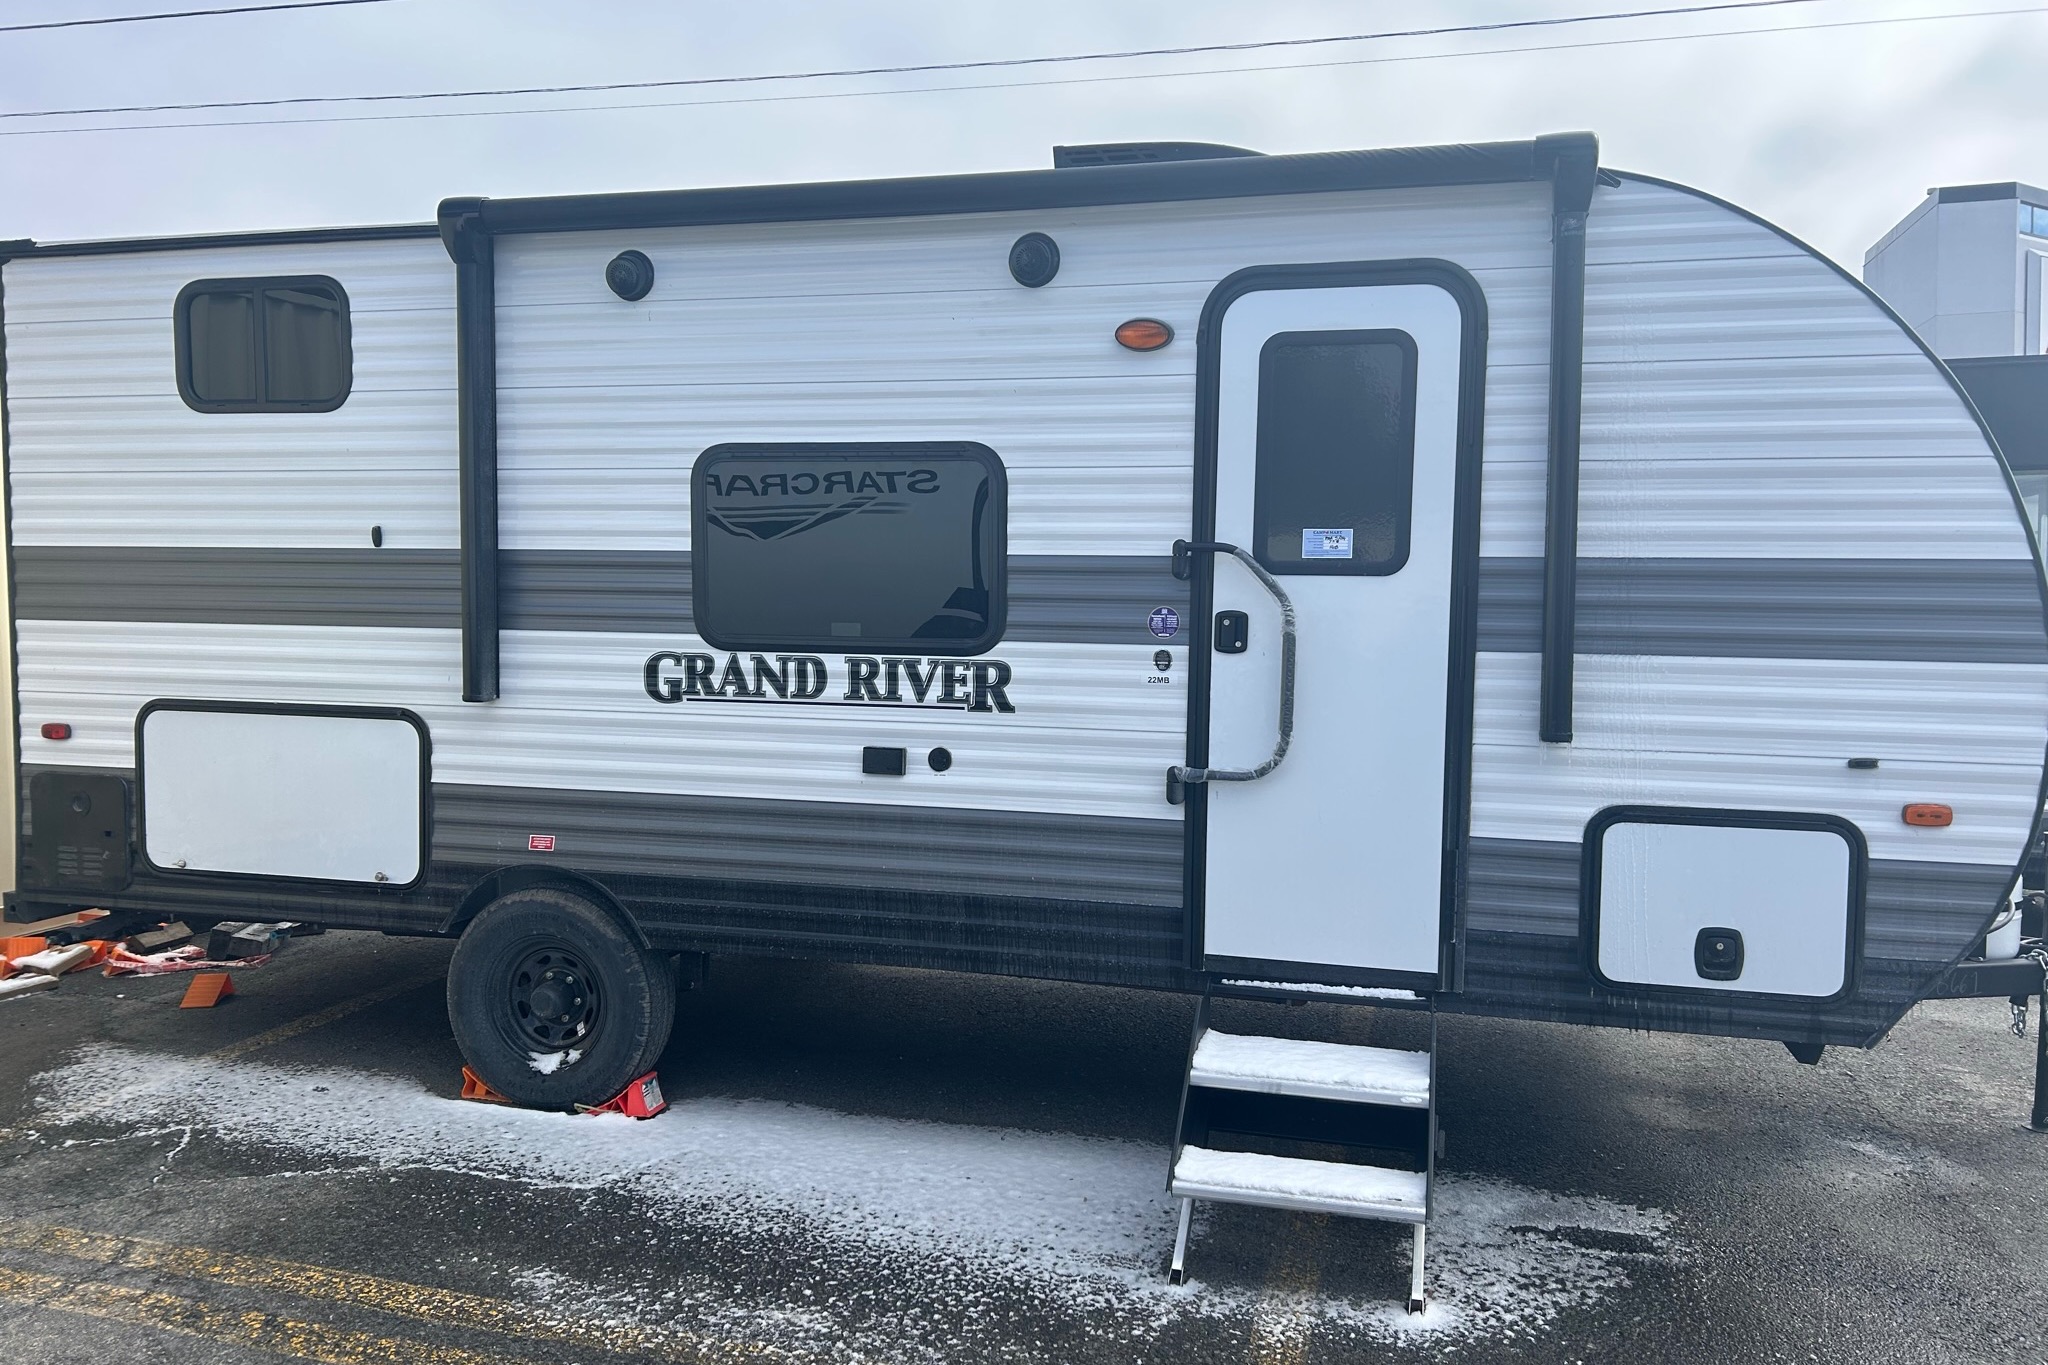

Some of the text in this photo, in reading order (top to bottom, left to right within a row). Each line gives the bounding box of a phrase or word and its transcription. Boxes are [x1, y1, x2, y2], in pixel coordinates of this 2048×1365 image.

[644, 651, 1016, 713] GRAND RIVER
[1147, 676, 1170, 684] 22MB
